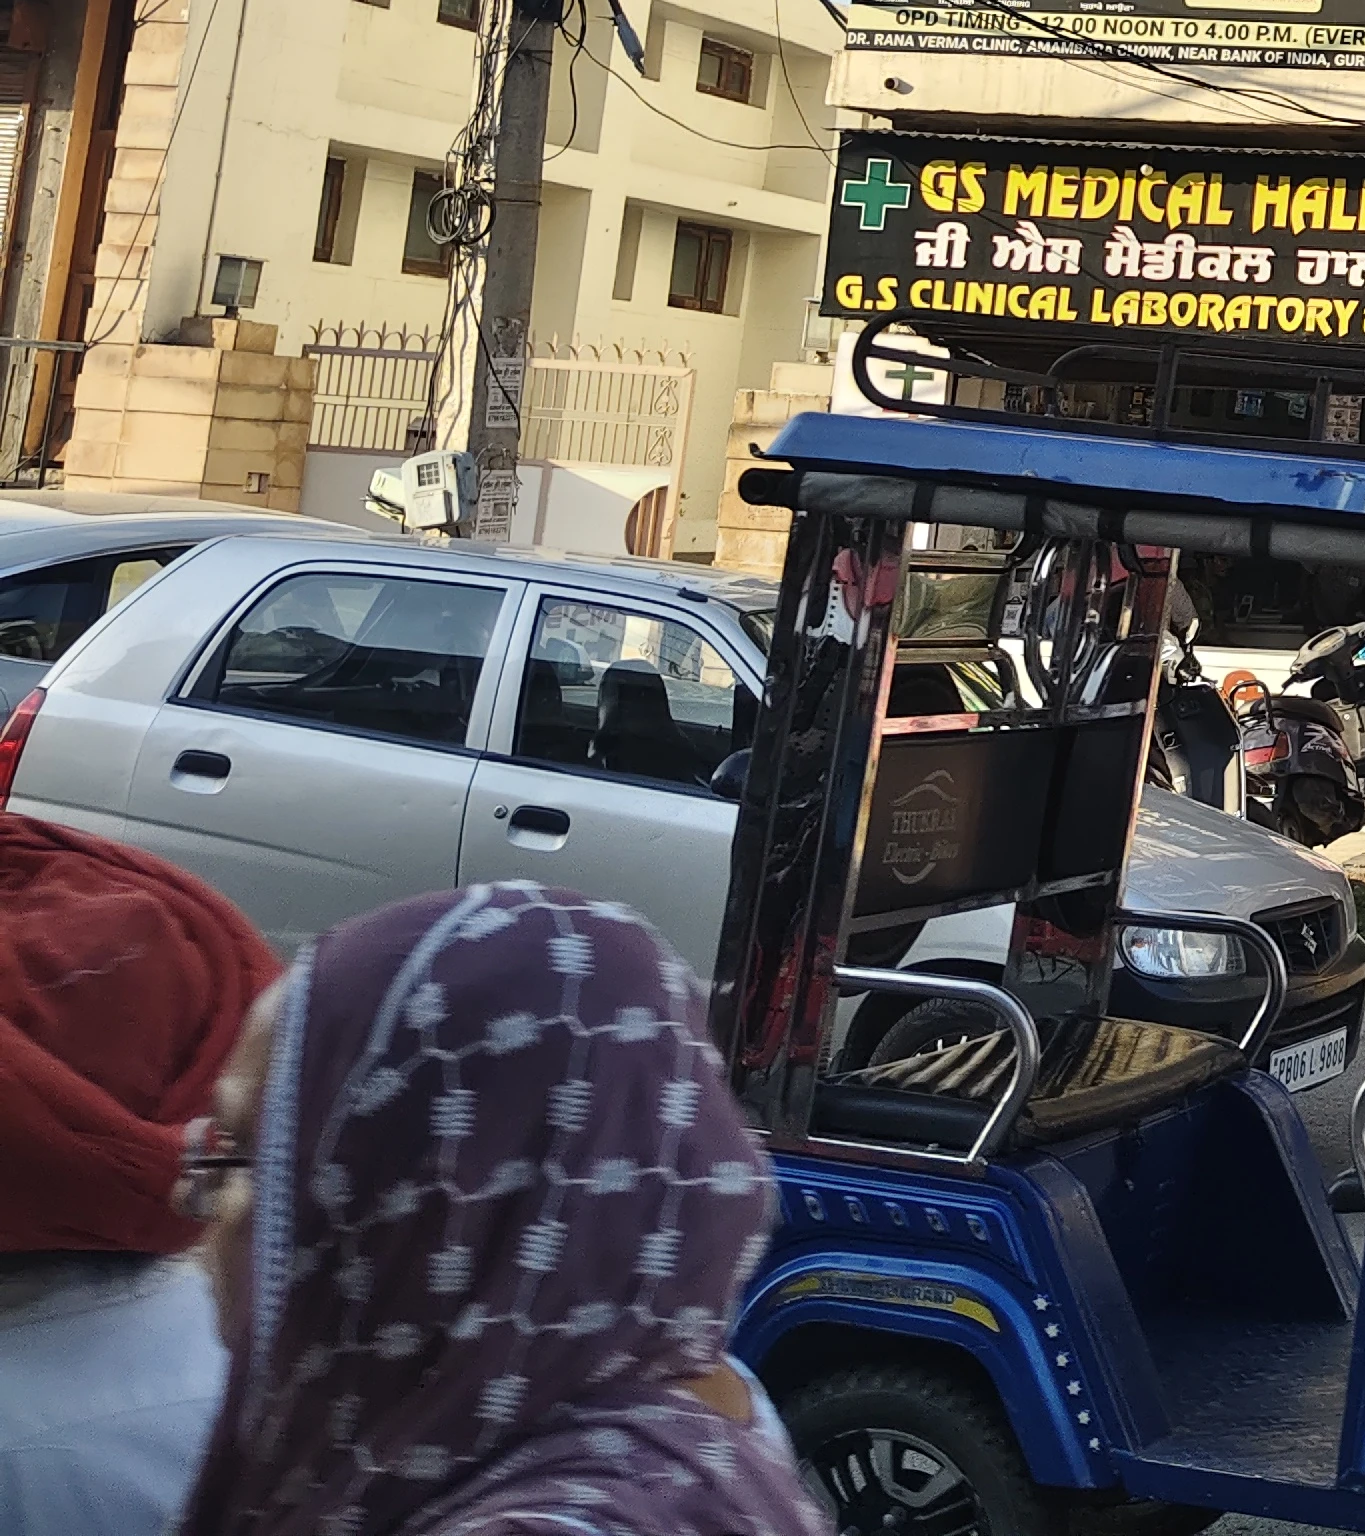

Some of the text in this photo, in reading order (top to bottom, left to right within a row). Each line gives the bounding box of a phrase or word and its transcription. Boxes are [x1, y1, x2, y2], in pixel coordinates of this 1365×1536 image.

[847, 32, 870, 46] DR.
[873, 33, 915, 48] RANA
[918, 35, 969, 50] VERMA
[971, 37, 1023, 54] CLINIC,
[1178, 47, 1218, 63] NEAR
[1221, 49, 1261, 65] BANK
[1265, 51, 1284, 65] OF
[1287, 52, 1331, 69] INDIA,
[896, 9, 938, 26] OPD
[945, 11, 1020, 32] TIMING
[1103, 19, 1164, 37] NOON
[1172, 21, 1198, 38] TO
[1205, 23, 1249, 41] 4.00
[1255, 26, 1298, 43] P.M.
[919, 159, 989, 214] GS
[1003, 163, 1233, 229] MEDICAL
[914, 221, 971, 271] ਜੀ
[991, 219, 1083, 276] ਐਸ
[1105, 225, 1274, 284] ਮੈਡੀਕਲ
[835, 275, 899, 311] G.S
[910, 277, 1079, 324] CLINICAL
[1090, 288, 1360, 337] LABORATORY
